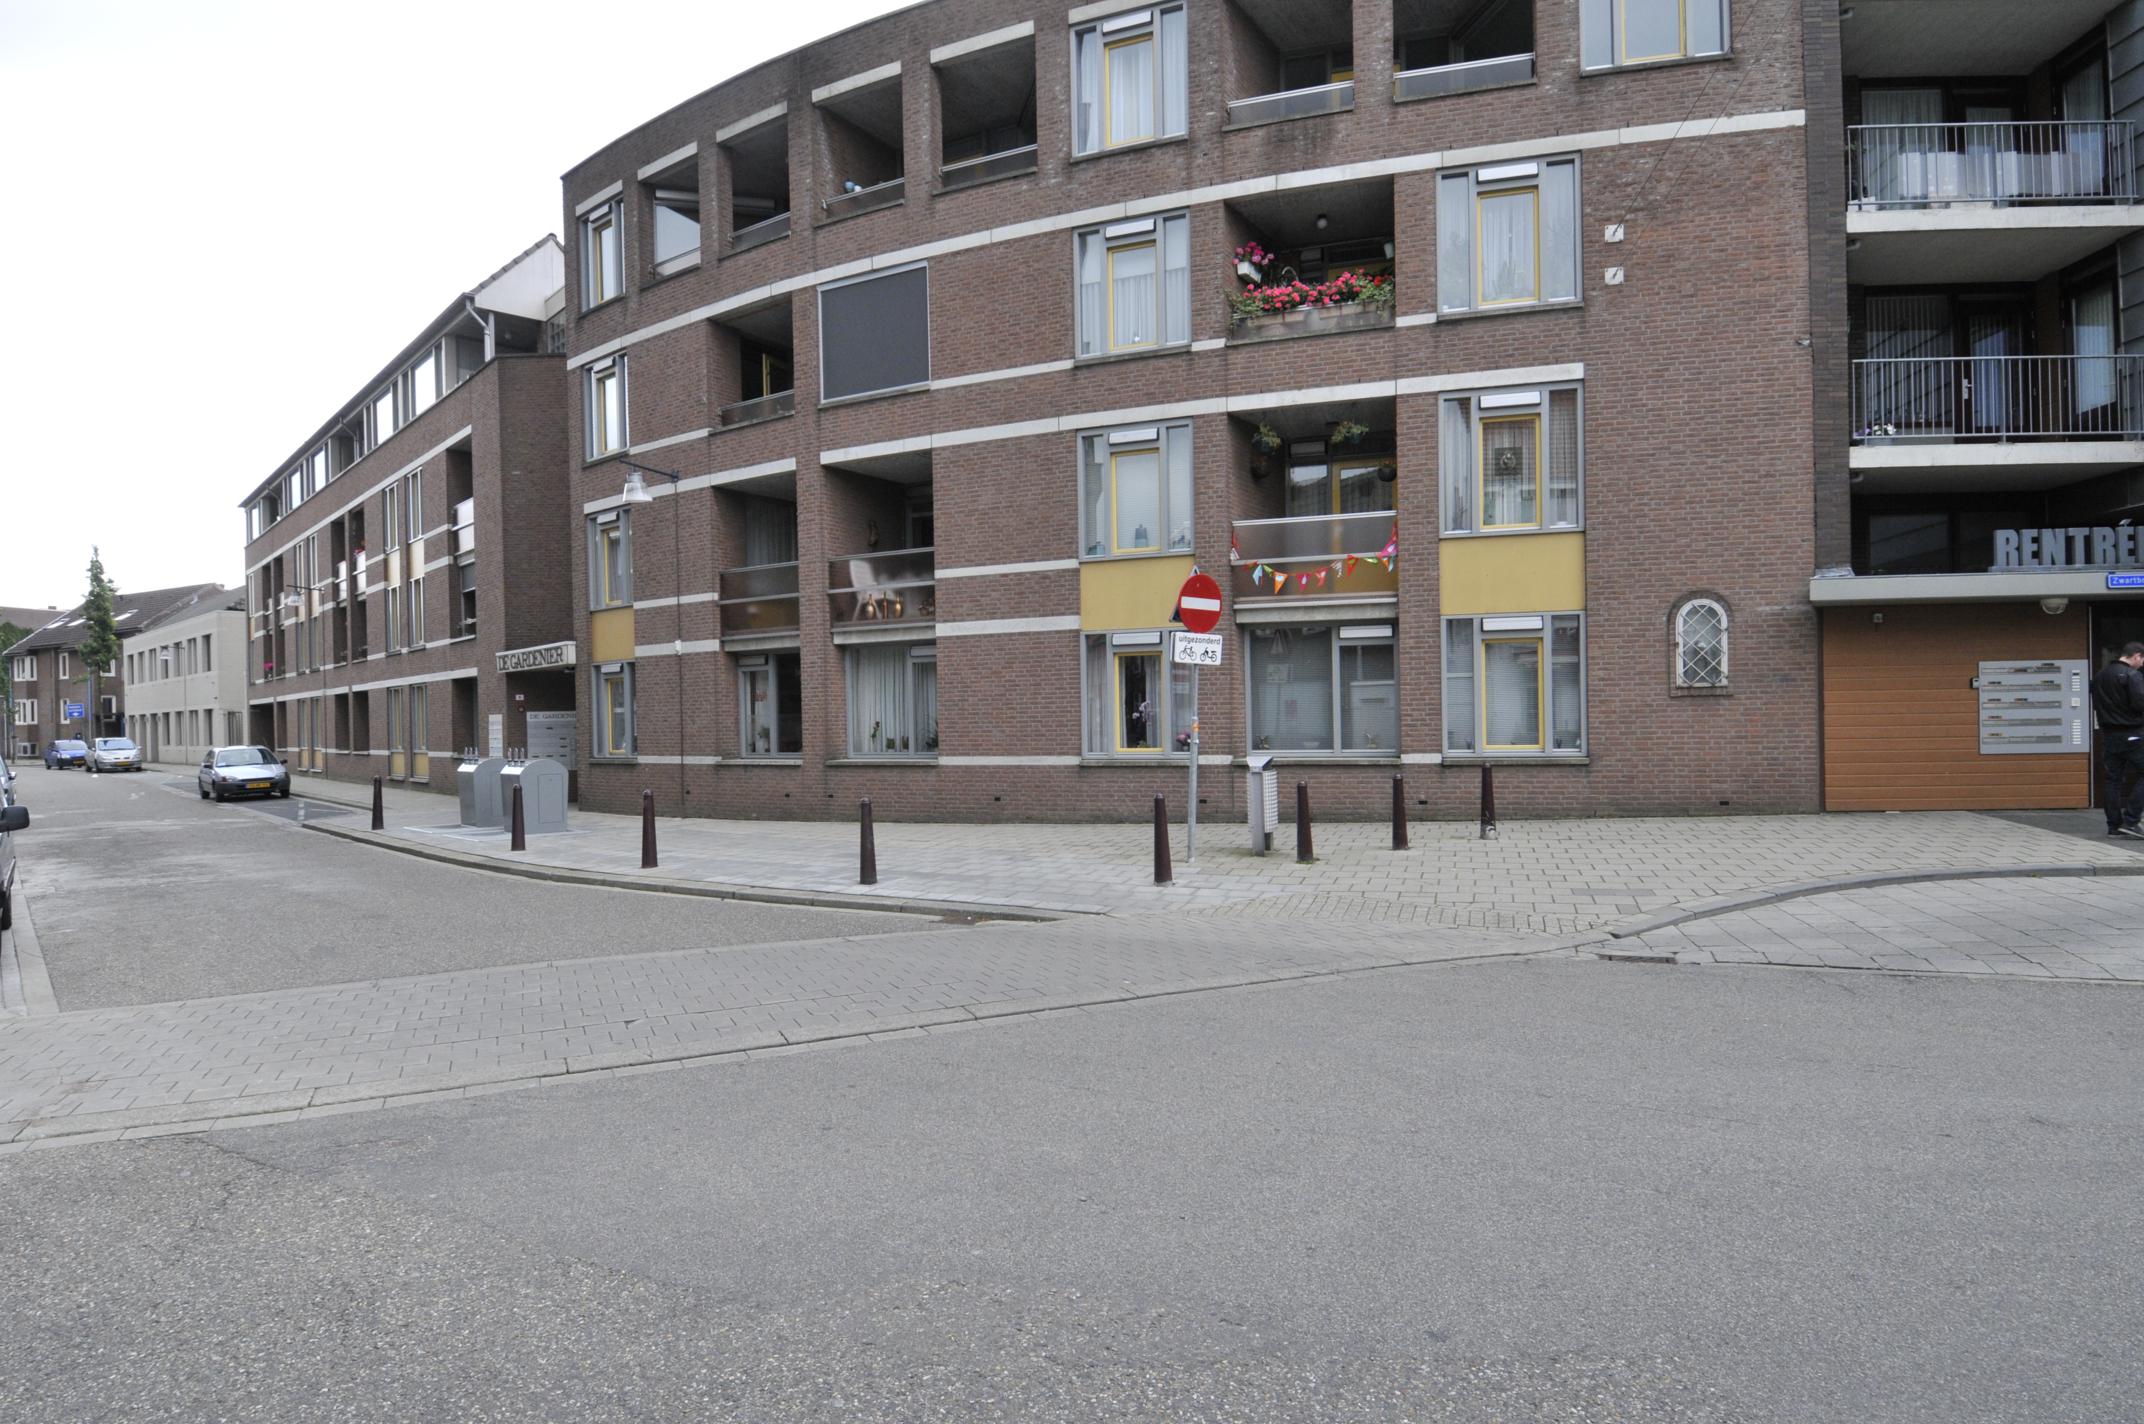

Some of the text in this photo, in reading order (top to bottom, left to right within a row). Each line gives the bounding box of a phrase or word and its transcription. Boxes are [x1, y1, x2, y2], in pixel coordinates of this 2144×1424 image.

[1178, 636, 1221, 645] uitgezonderd
[498, 646, 563, 671] DE GARDENIER
